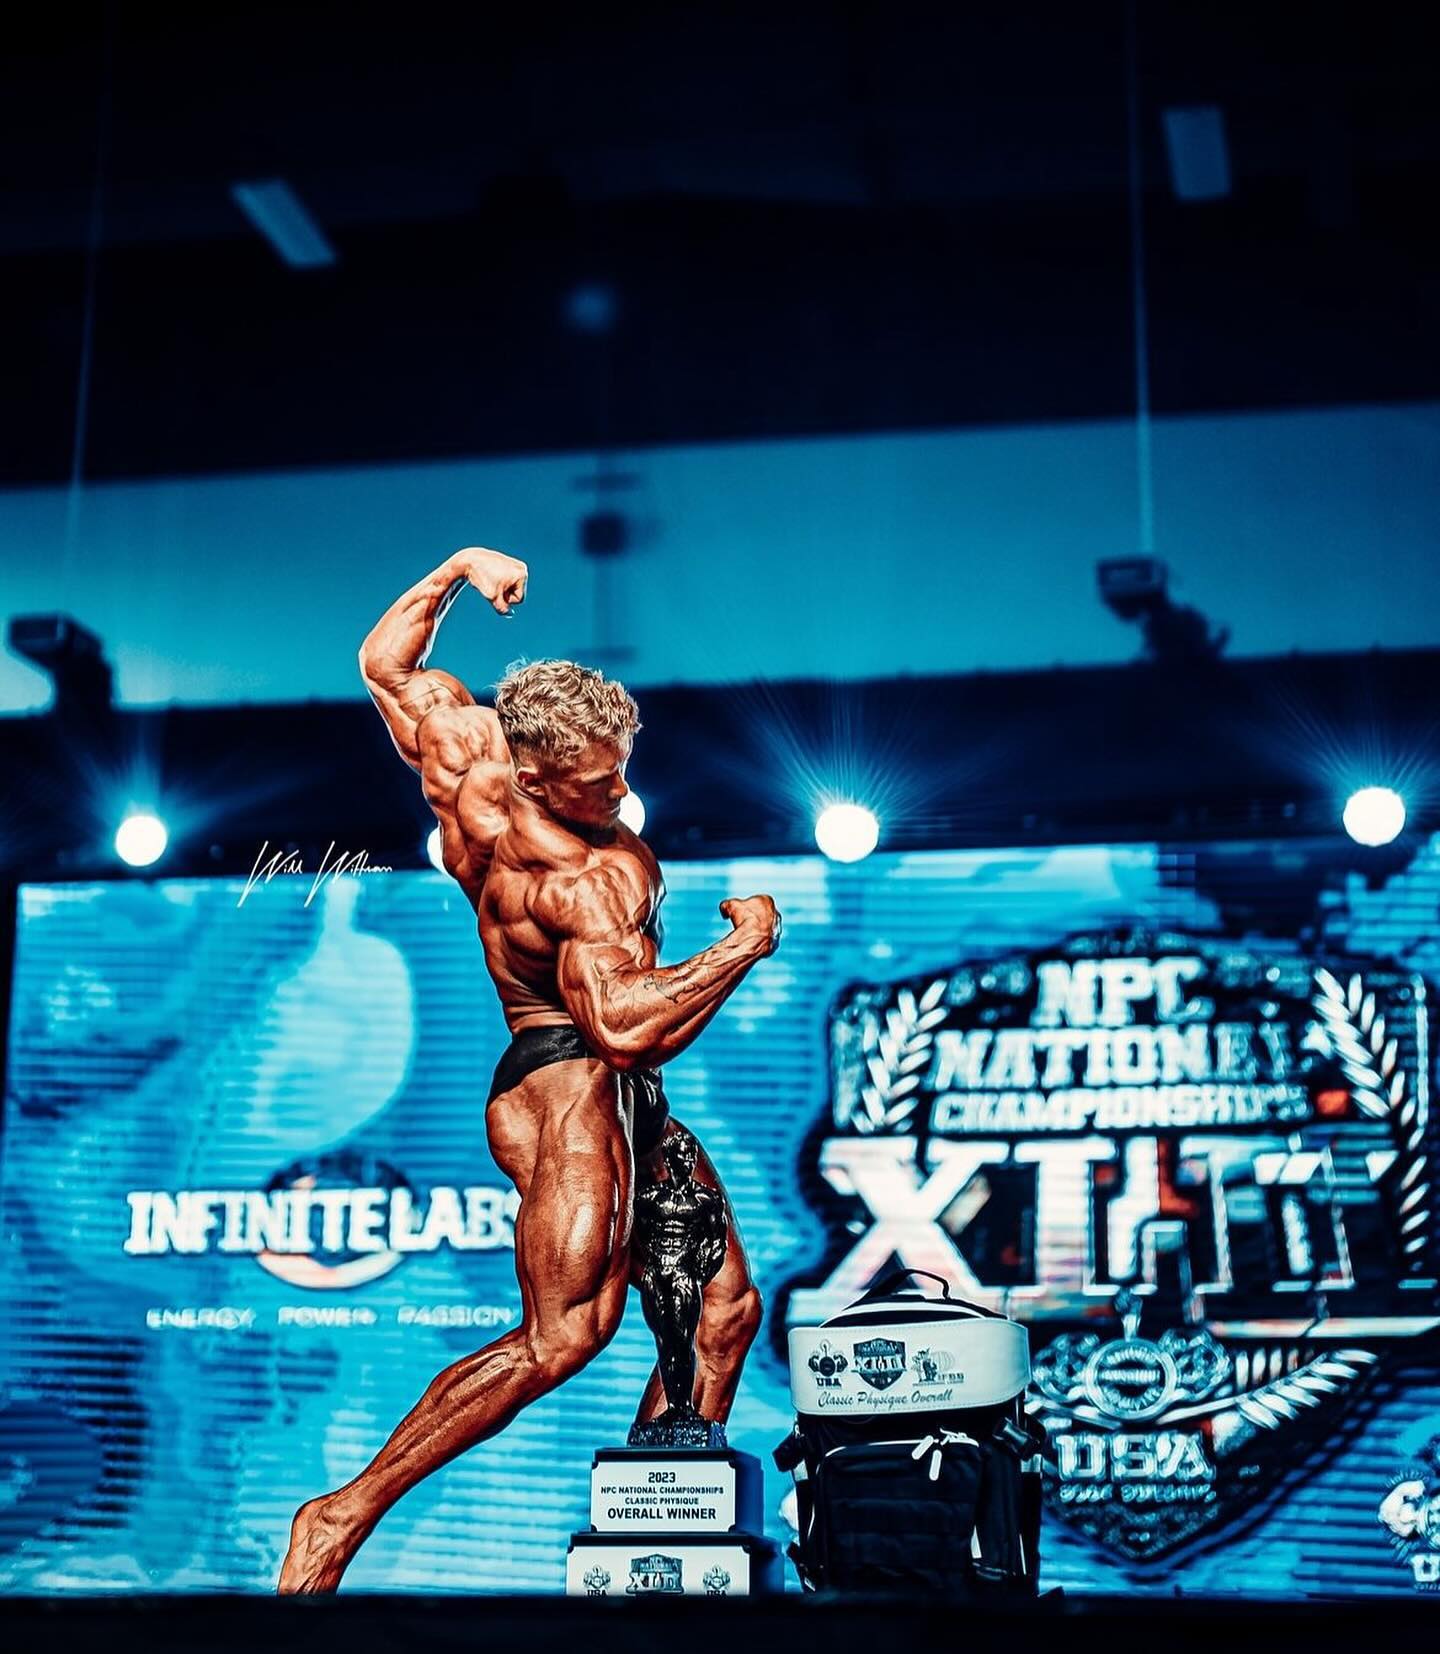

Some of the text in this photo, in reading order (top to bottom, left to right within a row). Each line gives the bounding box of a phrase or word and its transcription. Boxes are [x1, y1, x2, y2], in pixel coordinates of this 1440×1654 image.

[1030, 956, 1214, 1026] NPC
[146, 1305, 514, 1330] ENERGY POWER PASSION
[818, 1389, 954, 1409] Classic Physique Overall
[1054, 1433, 1216, 1480] USA
[648, 1471, 676, 1483] 2023
[601, 1486, 724, 1494] NPC NATIONAL CHAMPIONSHIPS
[625, 1497, 699, 1505] CLASSIC PHYSIQUE
[607, 1507, 717, 1519] OVERALL WINNER
